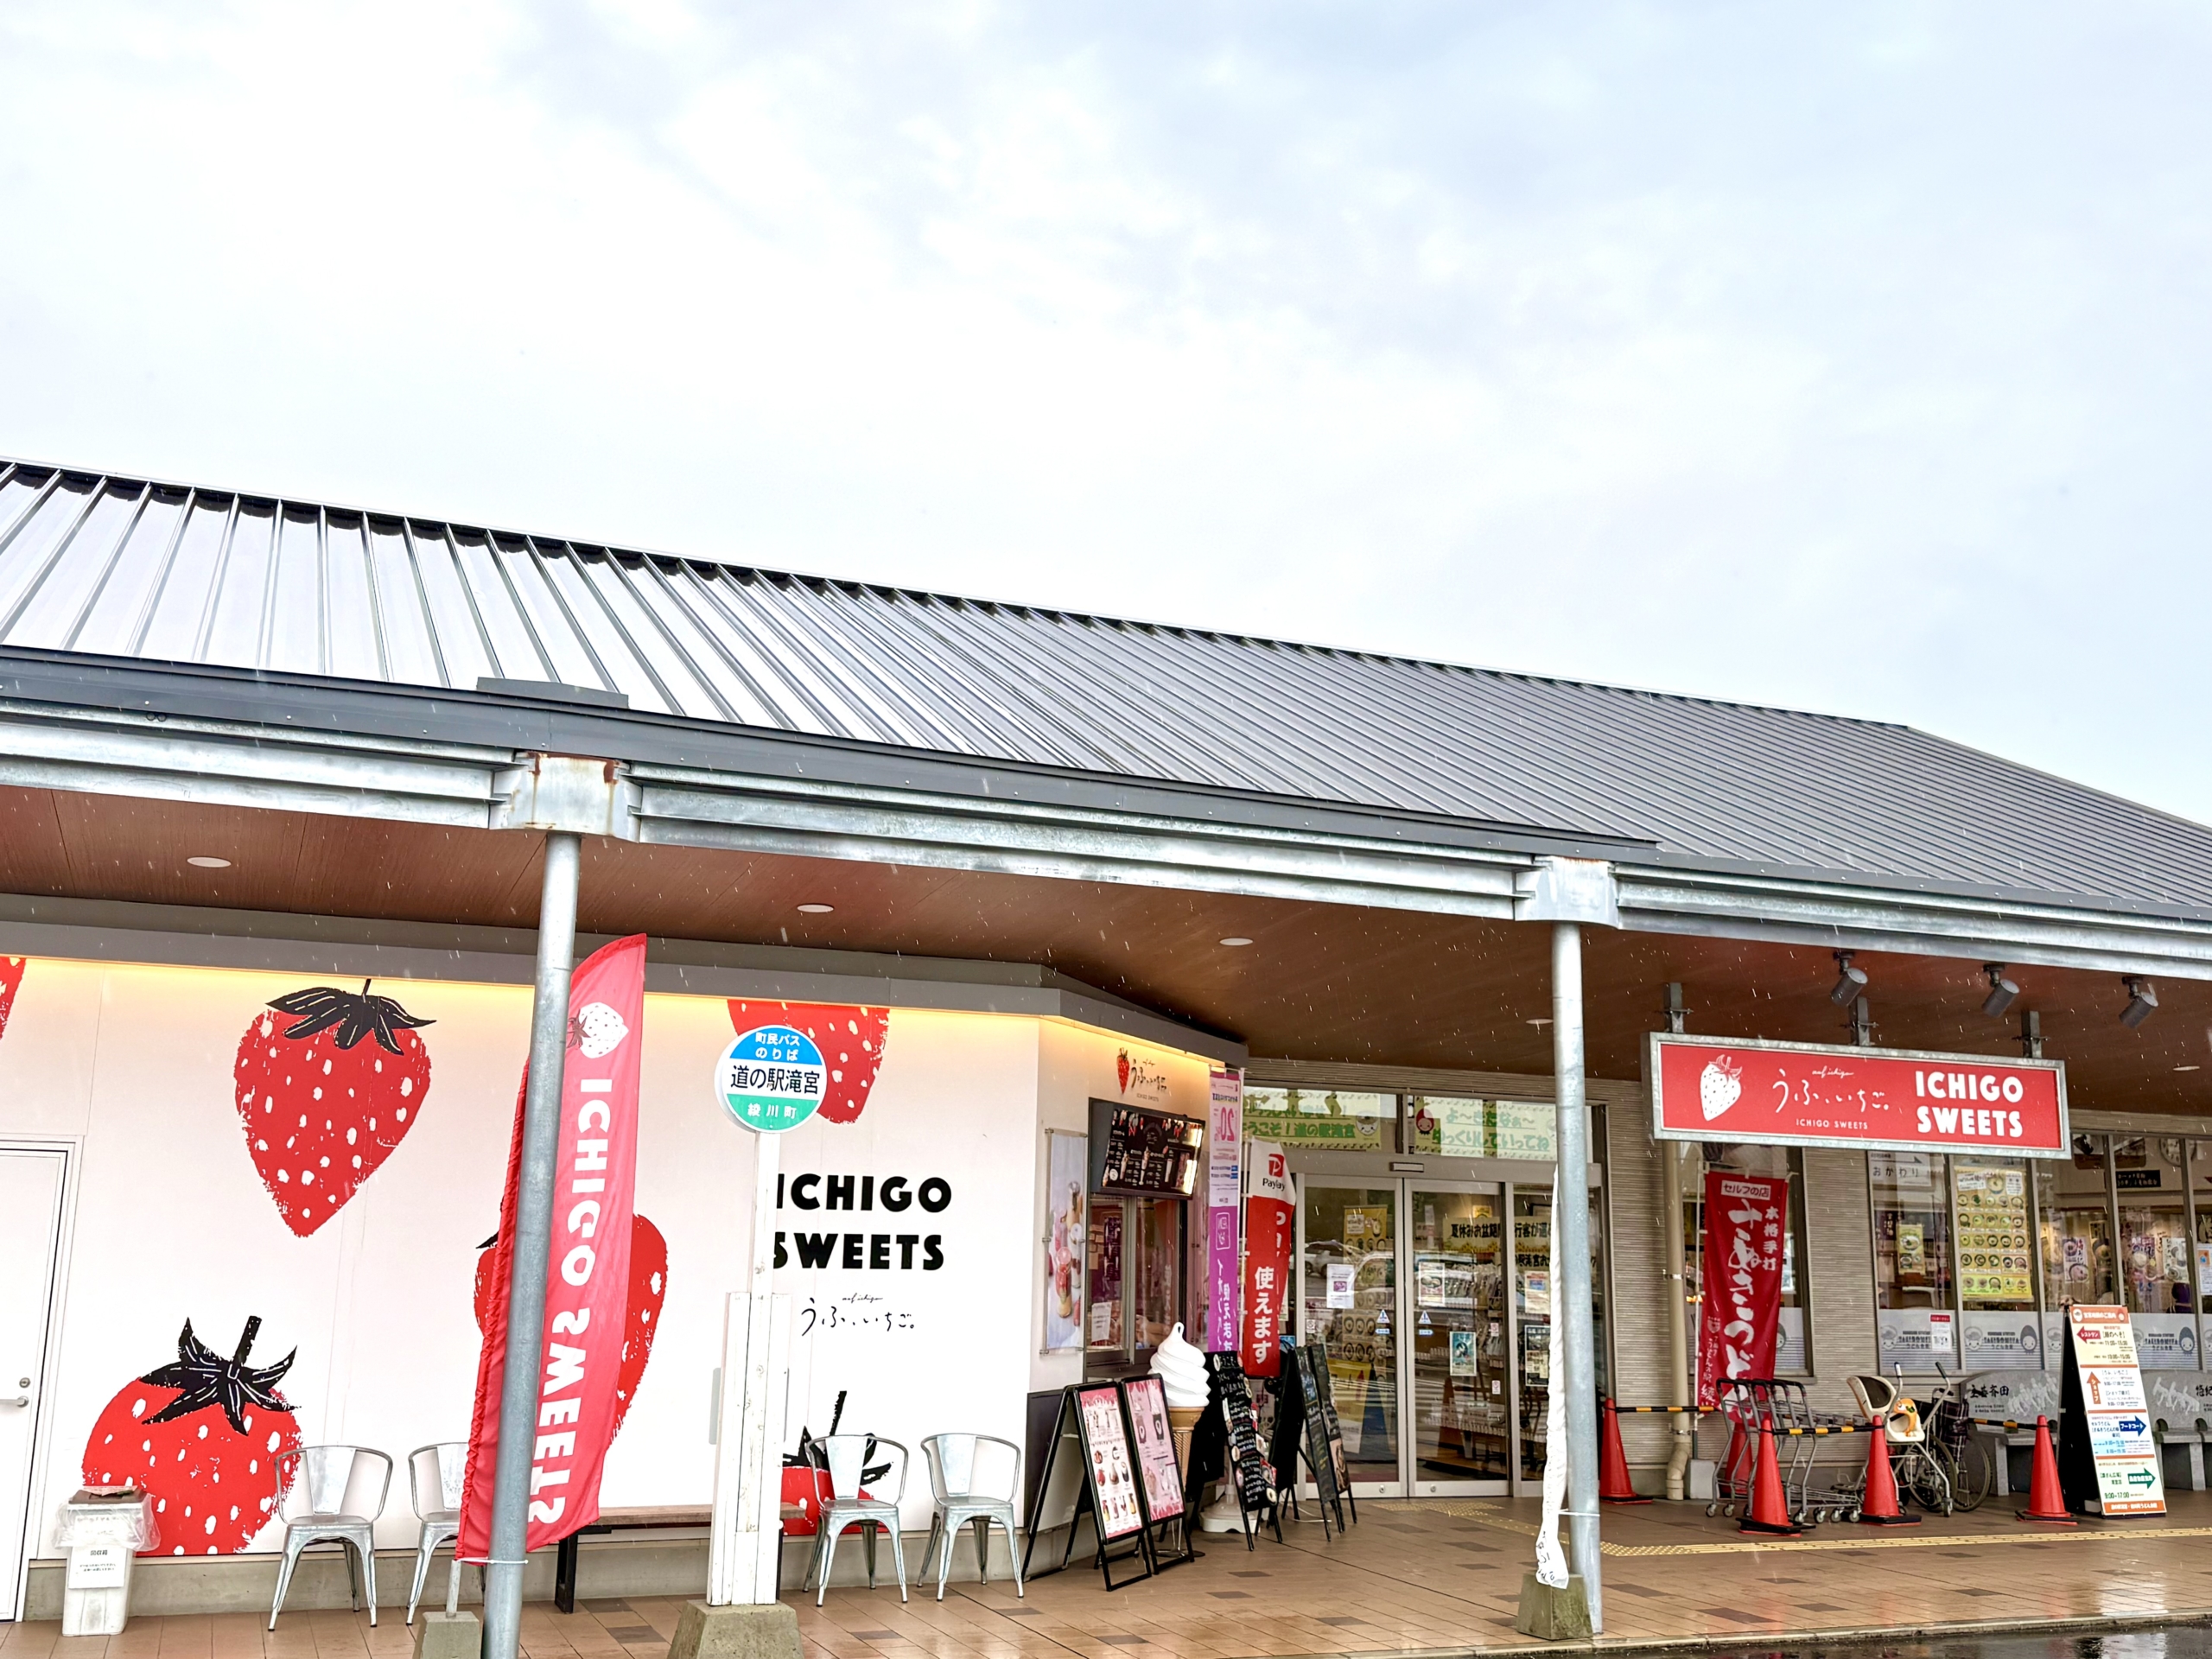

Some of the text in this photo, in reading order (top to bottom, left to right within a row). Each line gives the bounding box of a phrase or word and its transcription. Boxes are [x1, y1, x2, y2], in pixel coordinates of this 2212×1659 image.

[754, 1032, 801, 1046] 町民バス
[754, 1047, 799, 1061] のりば
[730, 1065, 820, 1095] 道の駅滝宮
[1915, 1070, 2024, 1103] ICHIGO
[747, 1103, 797, 1119] 綾川町
[1796, 1118, 1868, 1130] ICHIGO SWEETS
[1916, 1105, 2024, 1138] SWEETS
[776, 1173, 951, 1213] ICHIGO
[1262, 1178, 1286, 1192] Payay
[1722, 1184, 1770, 1199] セルフの店
[773, 1231, 944, 1271] SWEETS
[1762, 1205, 1780, 1271] 本格手打
[1253, 1266, 1275, 1364] 使えます
